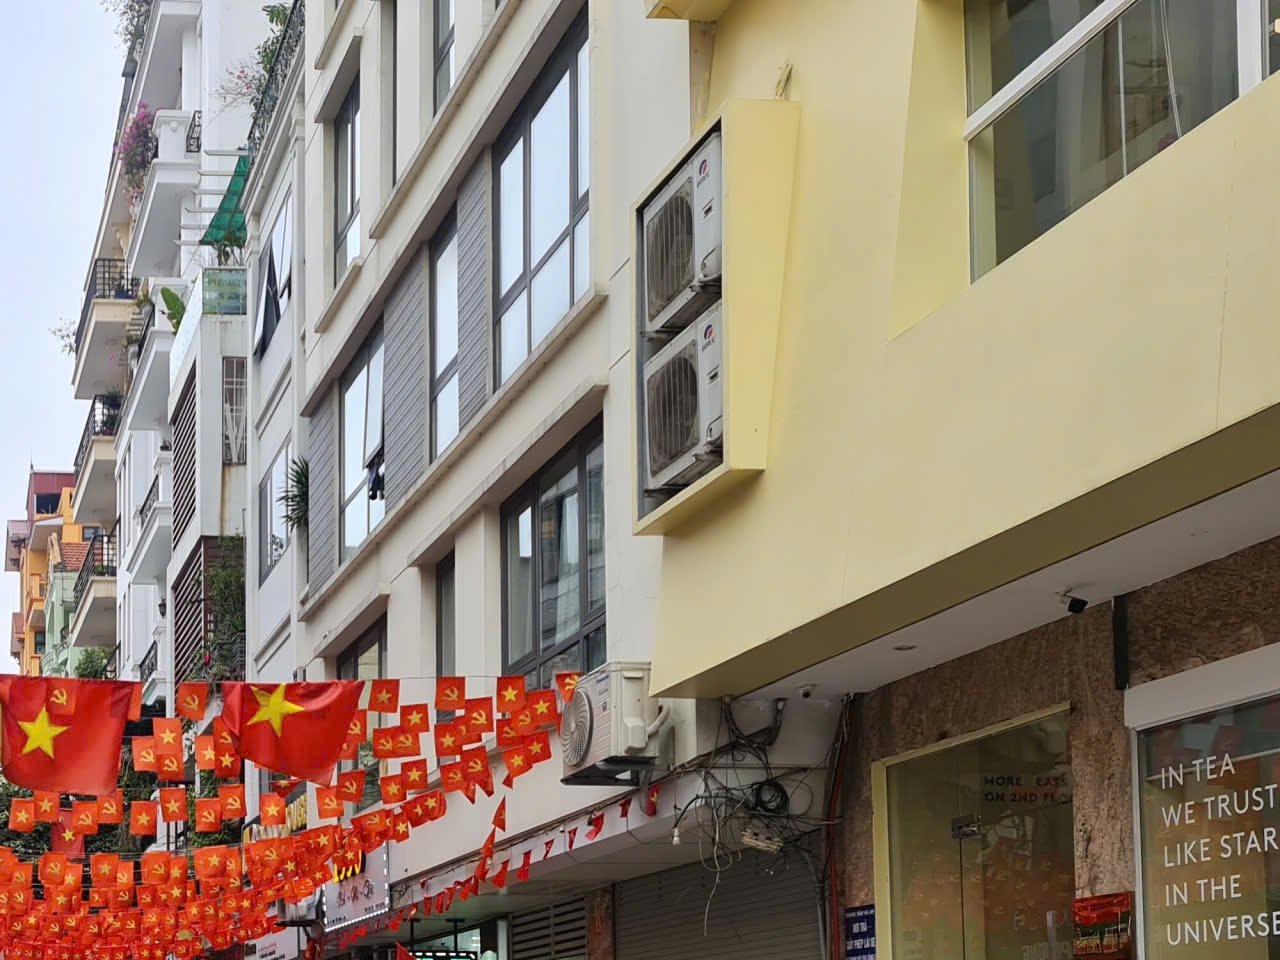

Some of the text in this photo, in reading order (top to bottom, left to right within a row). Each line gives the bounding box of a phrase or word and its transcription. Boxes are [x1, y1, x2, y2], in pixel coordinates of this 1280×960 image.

[1161, 752, 1236, 790] IN TEA
[1161, 784, 1278, 828] WE TRUST
[1164, 838, 1212, 868] LIKE
[1165, 874, 1242, 907] IN THE
[1167, 910, 1280, 946] UNIVERSE
